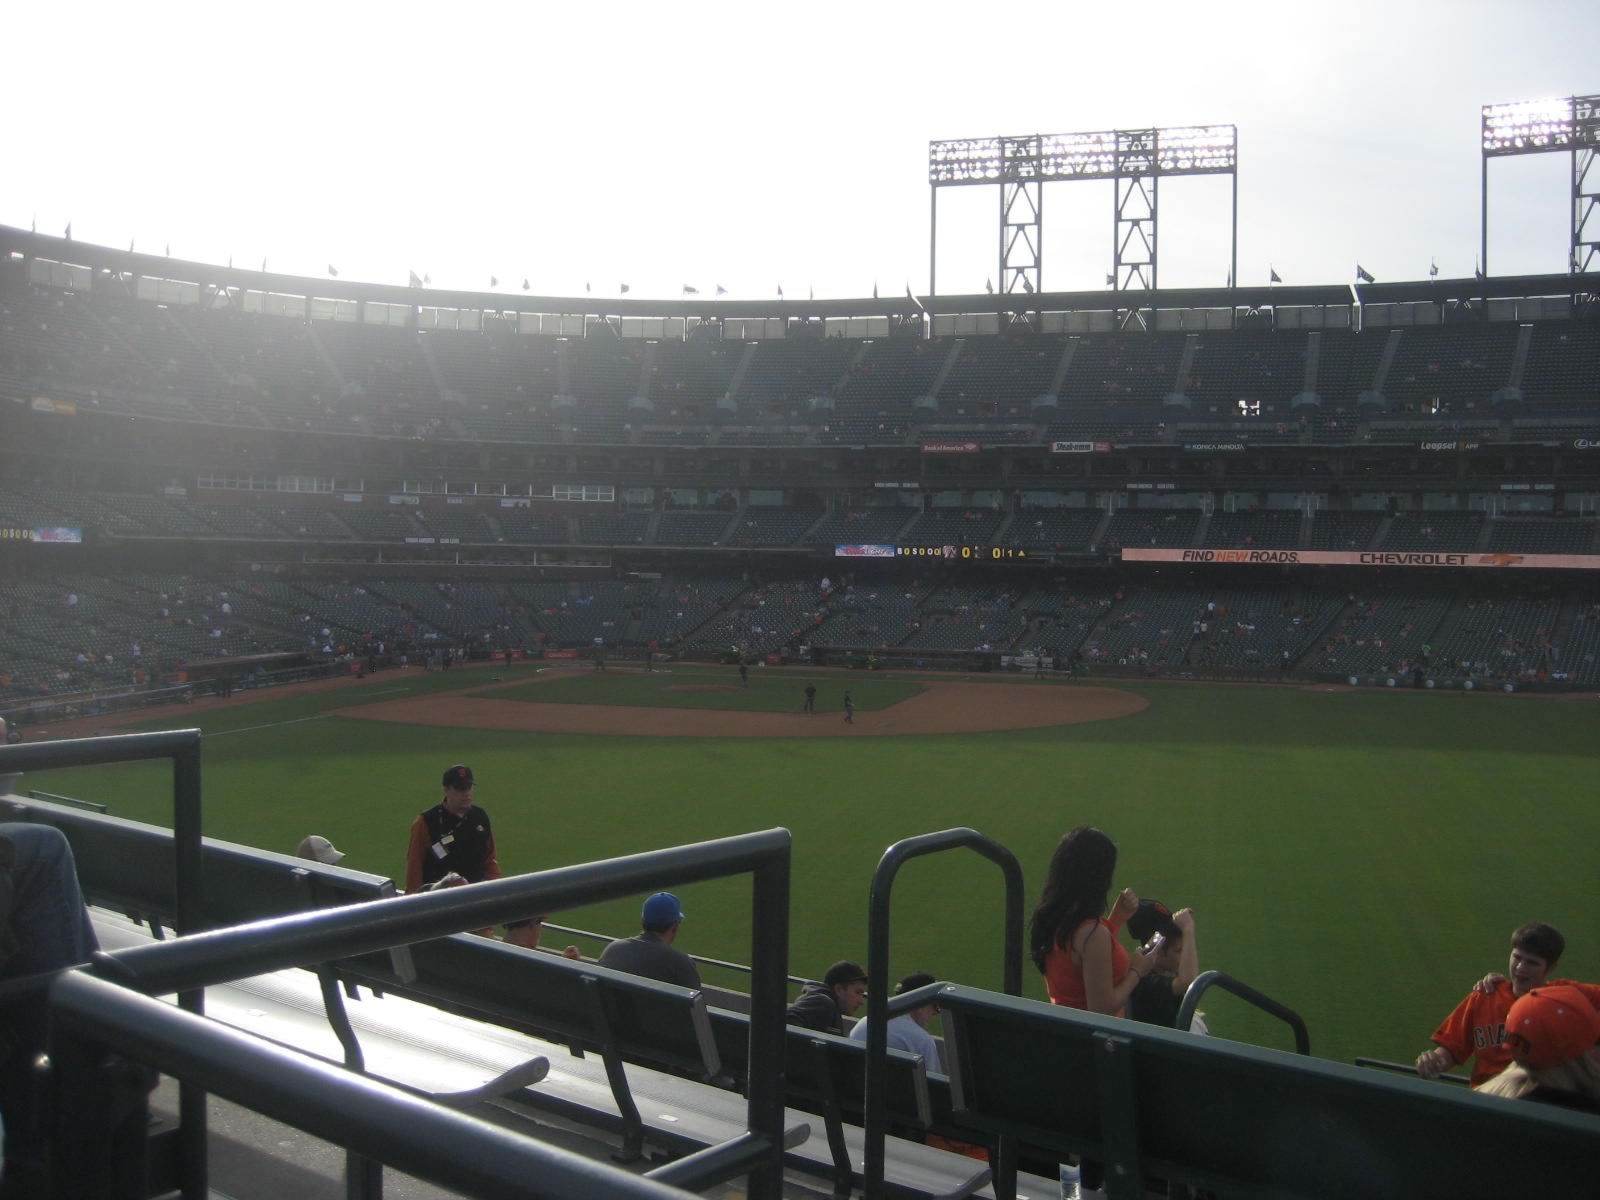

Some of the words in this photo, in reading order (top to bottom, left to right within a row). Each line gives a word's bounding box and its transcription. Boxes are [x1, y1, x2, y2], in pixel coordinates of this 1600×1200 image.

[1182, 550, 1214, 561] FIND
[1215, 551, 1249, 562] NEW
[1359, 553, 1469, 565] CHEVROLET
